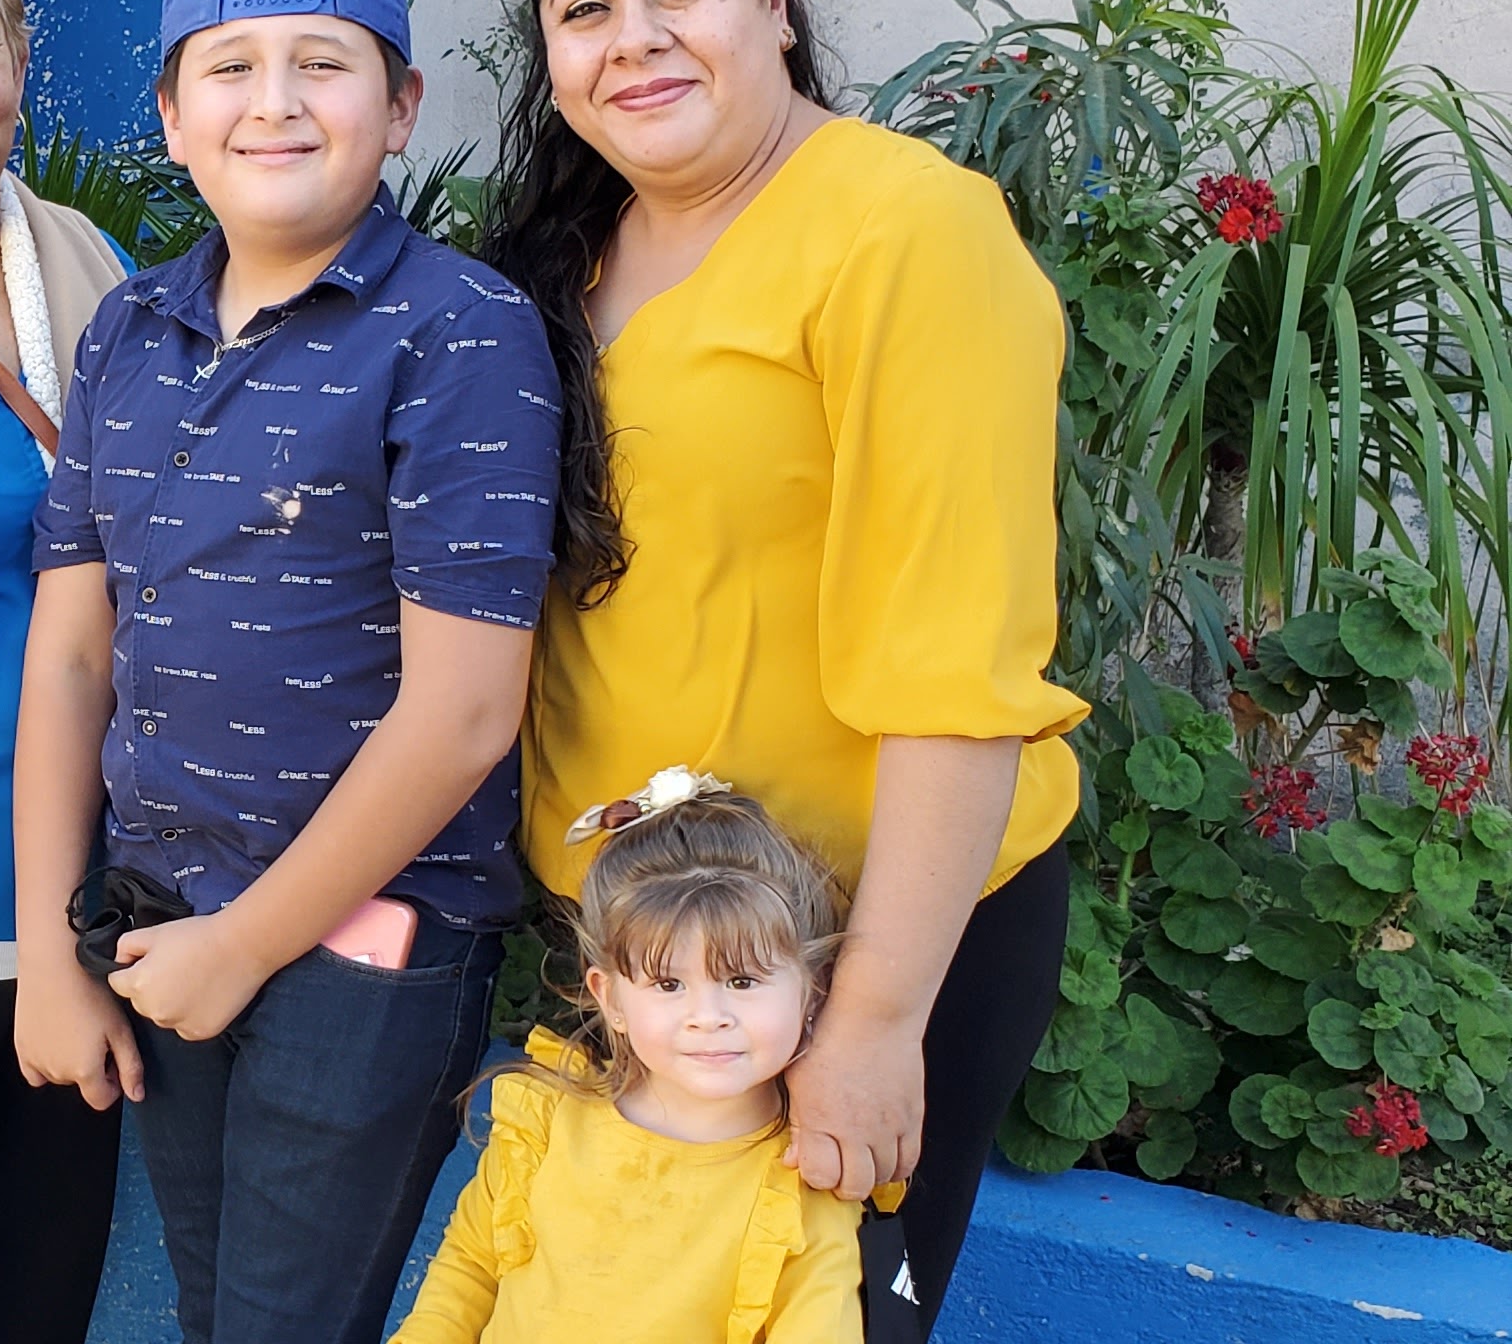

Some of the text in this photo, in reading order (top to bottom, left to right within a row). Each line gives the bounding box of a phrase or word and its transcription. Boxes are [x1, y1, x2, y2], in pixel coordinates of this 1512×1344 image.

[459, 340, 477, 348] TAKE
[459, 441, 498, 452] fearLESS
[295, 482, 333, 496] fearLESS
[239, 524, 276, 536] fearLESS
[372, 531, 390, 540] TAKE
[459, 541, 481, 551] TAKE
[188, 566, 220, 581] fearLESS
[290, 575, 311, 585] TAKE
[230, 621, 272, 632] TAKE risks
[361, 622, 397, 634] fearLESS
[285, 677, 322, 689] fearLESS
[229, 720, 266, 735] fearLESS
[183, 760, 216, 777] fearLESS
[288, 771, 309, 780] TAKE
[238, 812, 257, 822] TAKE
